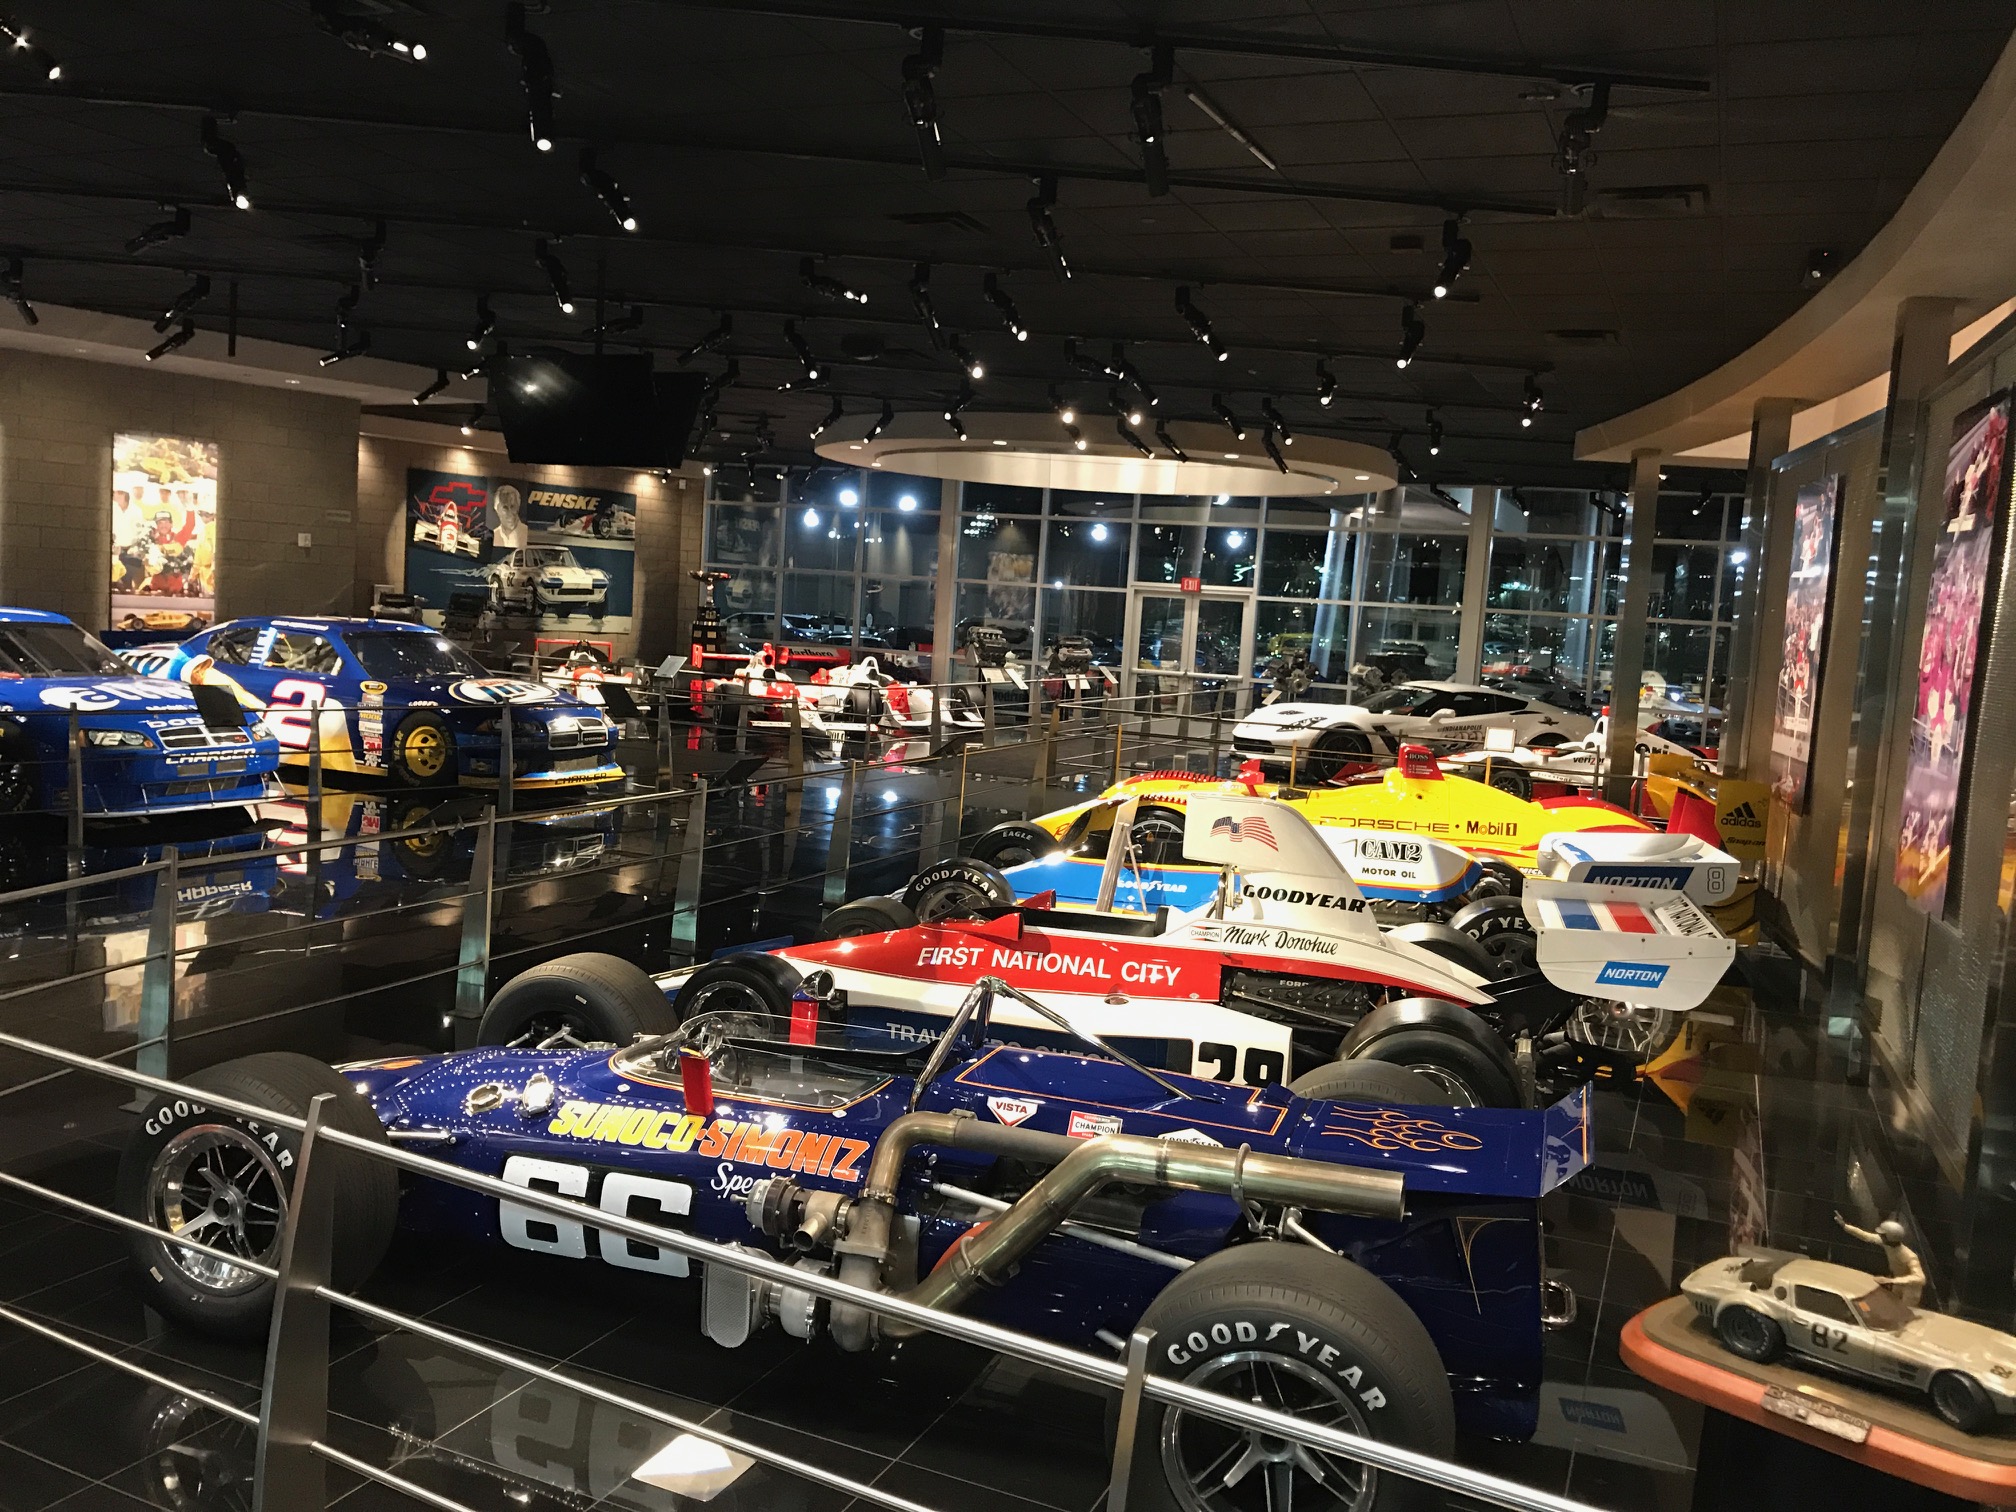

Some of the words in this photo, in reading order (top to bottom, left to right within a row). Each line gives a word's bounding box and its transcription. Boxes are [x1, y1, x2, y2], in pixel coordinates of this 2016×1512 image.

[528, 490, 601, 511] PENSKE
[1183, 579, 1200, 592] EXIT
[148, 717, 206, 730] DOD
[263, 679, 325, 749] 2
[92, 730, 123, 746] 12
[165, 748, 257, 766] CHARGER
[1720, 816, 1762, 829] adidas
[1002, 830, 1033, 842] EAGLE
[1359, 837, 1423, 864] CAM2
[1362, 866, 1397, 878] MOTOR
[1401, 870, 1417, 880] OIL
[1706, 866, 1725, 895] 8
[1243, 884, 1367, 913] GOODYEAR
[1190, 929, 1220, 939] CHAMPION
[1223, 926, 1269, 946] Mark
[1274, 930, 1339, 956] Donohue
[917, 946, 984, 967] FIRST
[990, 951, 1112, 980] NATIONAL
[1121, 960, 1182, 986] CITY
[1604, 967, 1663, 983] NORTON
[995, 1100, 1028, 1115] VISTA
[145, 1100, 294, 1171] GOODEAR
[1074, 1120, 1116, 1135] CHAMPION
[548, 1101, 706, 1153] SUNOCO
[698, 1118, 871, 1183] SIMONIZ
[500, 1154, 693, 1279] 66
[1810, 1321, 1849, 1356] 82
